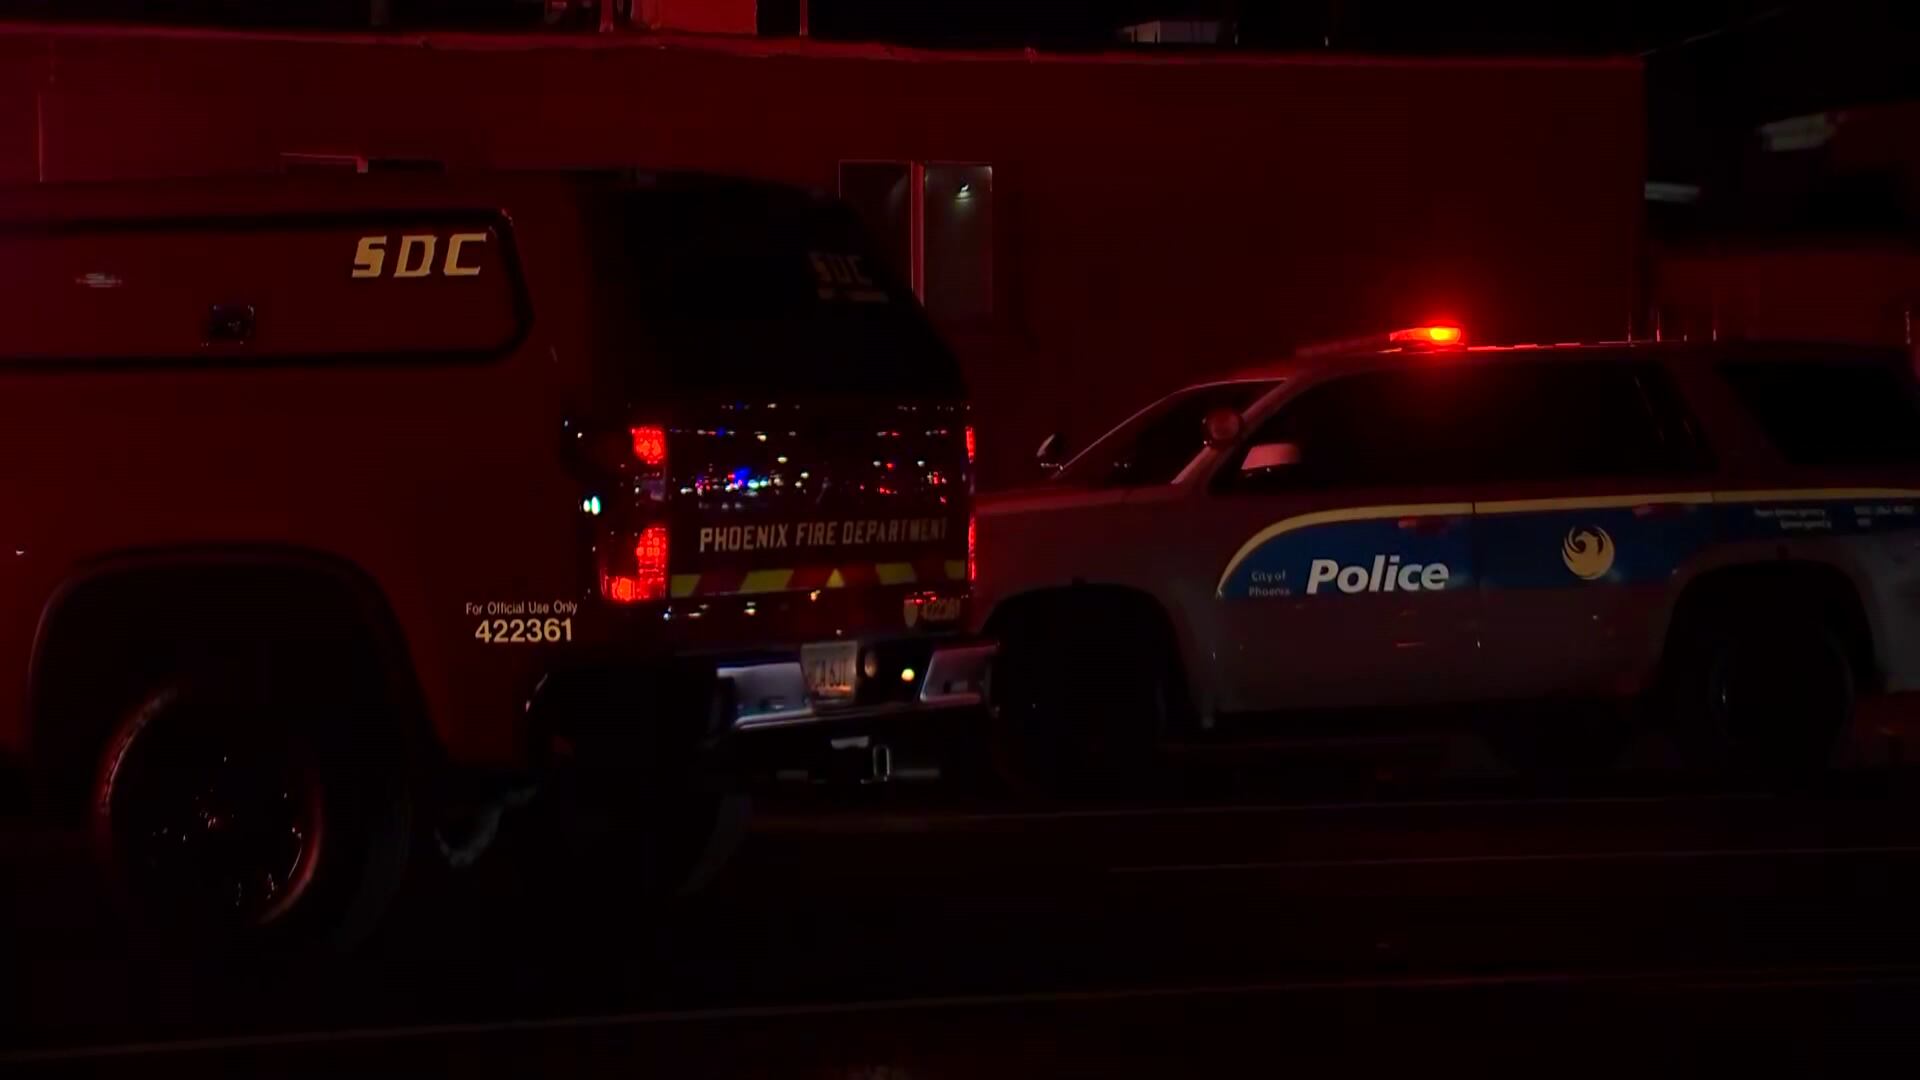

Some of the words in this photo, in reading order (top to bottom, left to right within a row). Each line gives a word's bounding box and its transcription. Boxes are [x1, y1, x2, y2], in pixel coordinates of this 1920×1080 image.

[351, 232, 488, 279] SDC
[699, 523, 789, 552] PHOENIX
[796, 520, 838, 546] FIRE
[842, 516, 948, 545] DEPARTMENT
[1251, 570, 1272, 583] City
[1274, 569, 1286, 582] of
[1306, 554, 1449, 595] Police
[465, 601, 483, 615] For
[487, 600, 525, 615] Official
[528, 600, 550, 614] Use
[553, 599, 578, 616] Only
[474, 617, 572, 643] 422361
